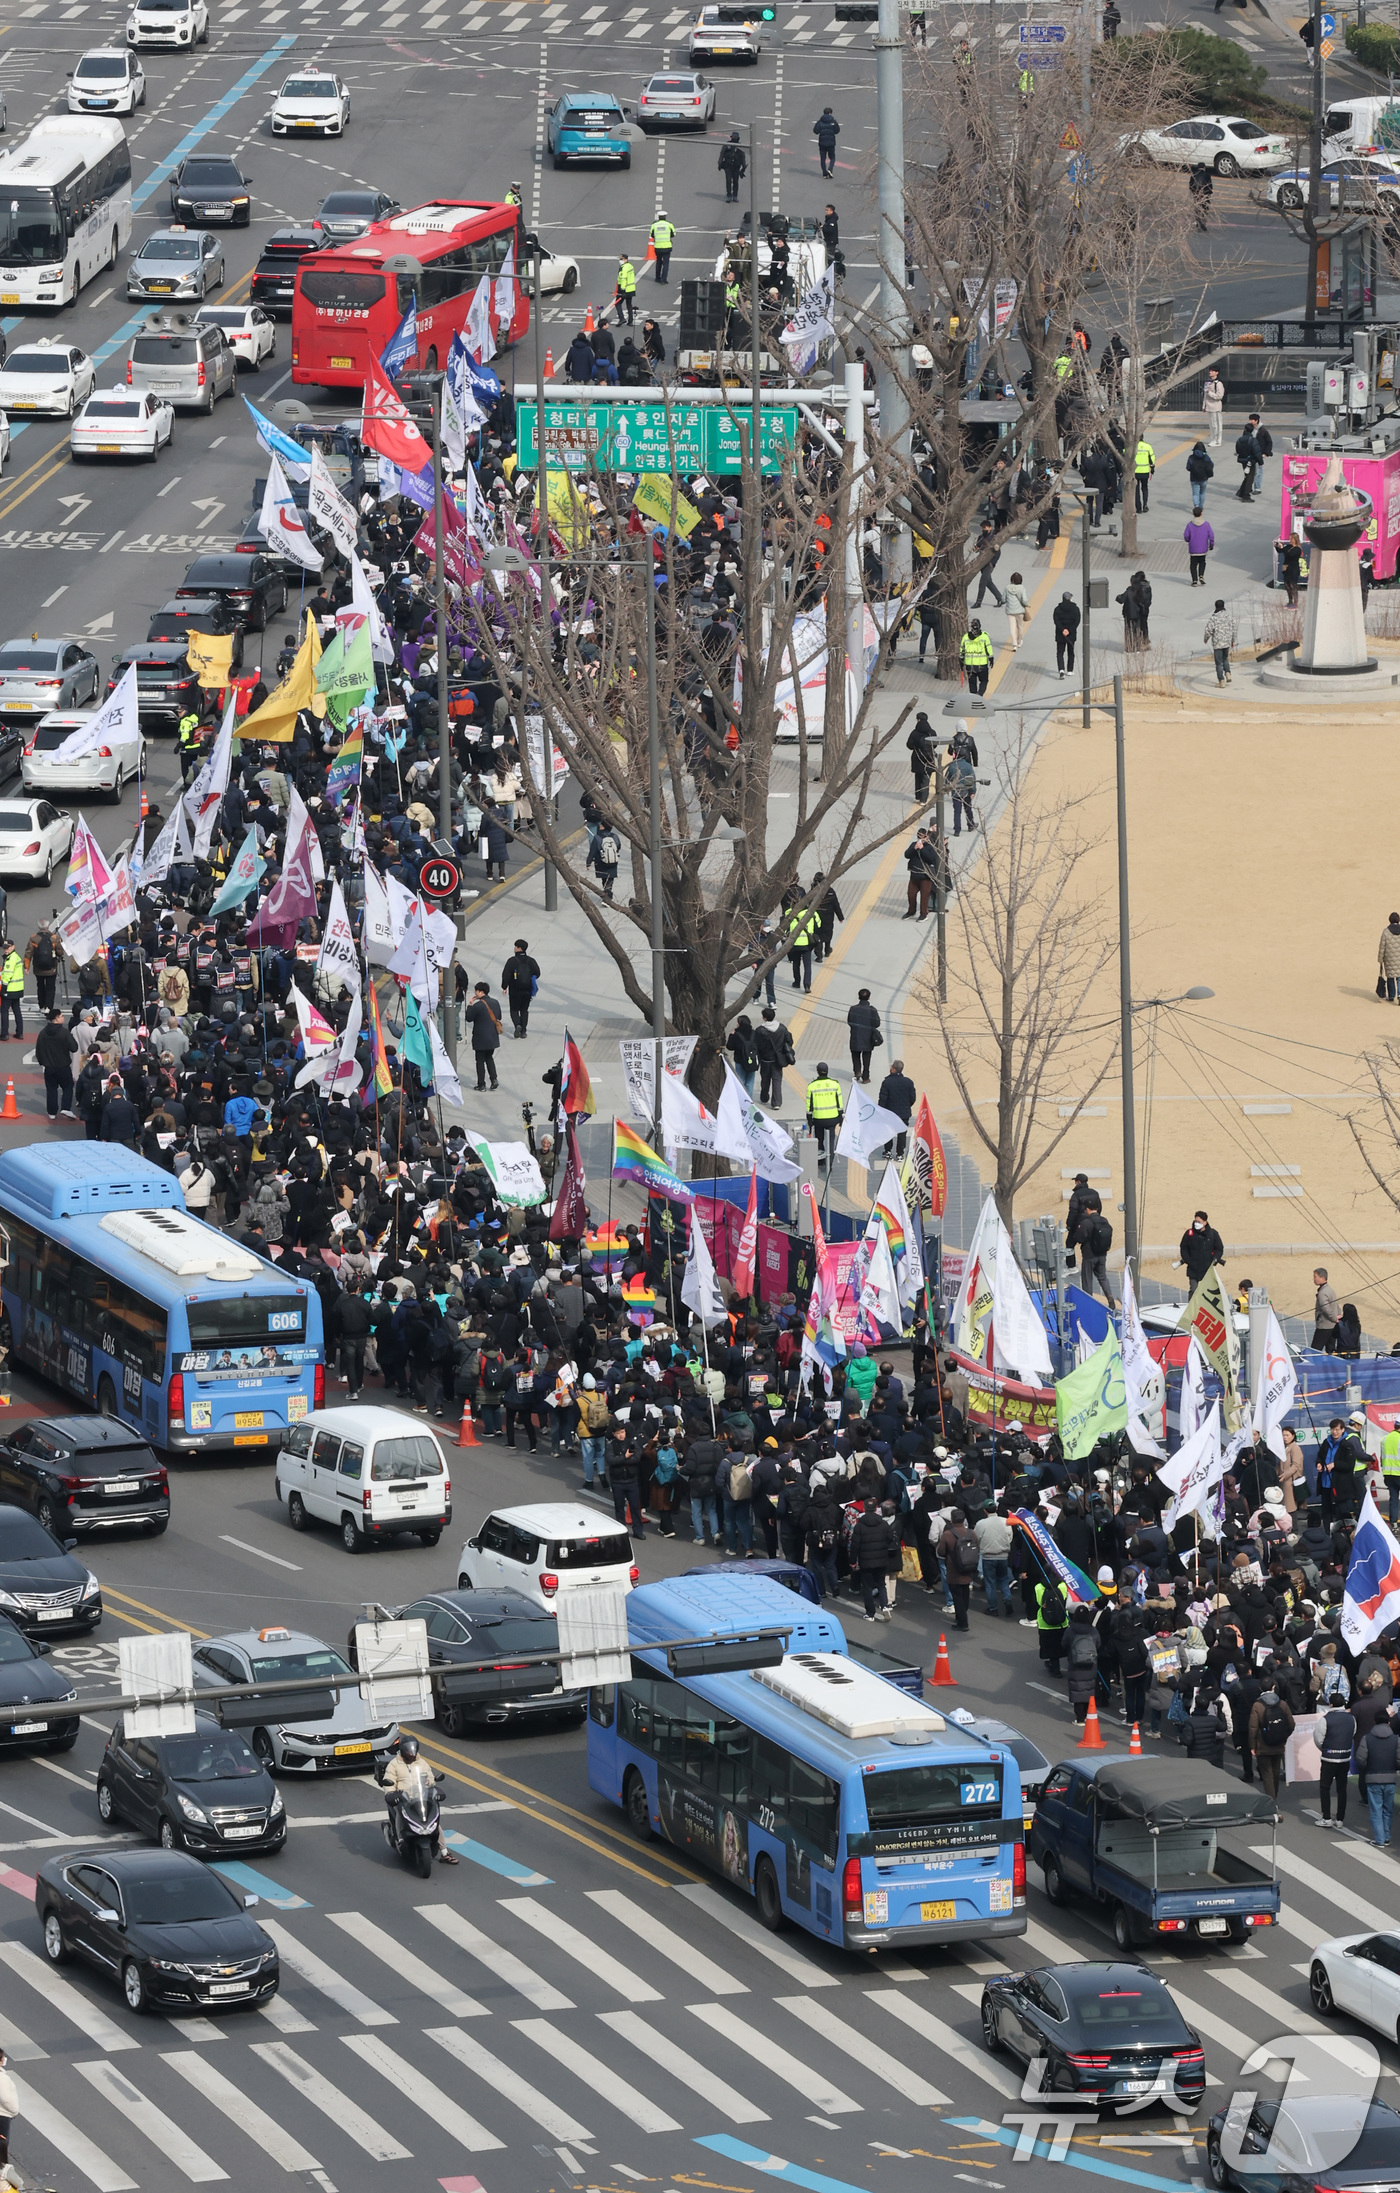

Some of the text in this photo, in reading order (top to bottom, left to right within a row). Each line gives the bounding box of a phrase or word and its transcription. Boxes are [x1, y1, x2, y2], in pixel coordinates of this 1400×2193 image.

[635, 412, 699, 426] 흥인지문
[617, 438, 628, 446] 50
[0, 530, 105, 551] 삼청동
[120, 533, 239, 554] 삼청동
[429, 869, 450, 887] 40
[272, 1313, 299, 1330] 606
[102, 1332, 116, 1356] 606
[67, 1347, 88, 1385] 야당
[180, 1355, 210, 1371] 야당
[123, 1365, 142, 1397] 야당
[237, 1379, 263, 1388] 신길교통
[1003, 1399, 1033, 1423] 완전
[32, 1724, 46, 1732] 2503
[965, 1782, 996, 1803] 272
[758, 1804, 775, 1833] 272
[898, 1830, 929, 1838] LEGEND
[924, 1861, 954, 1871] 북부운수
[990, 1882, 1001, 1892] 주의
[875, 1893, 887, 1904] 주의
[1196, 1898, 1235, 1907] HYUNDAI
